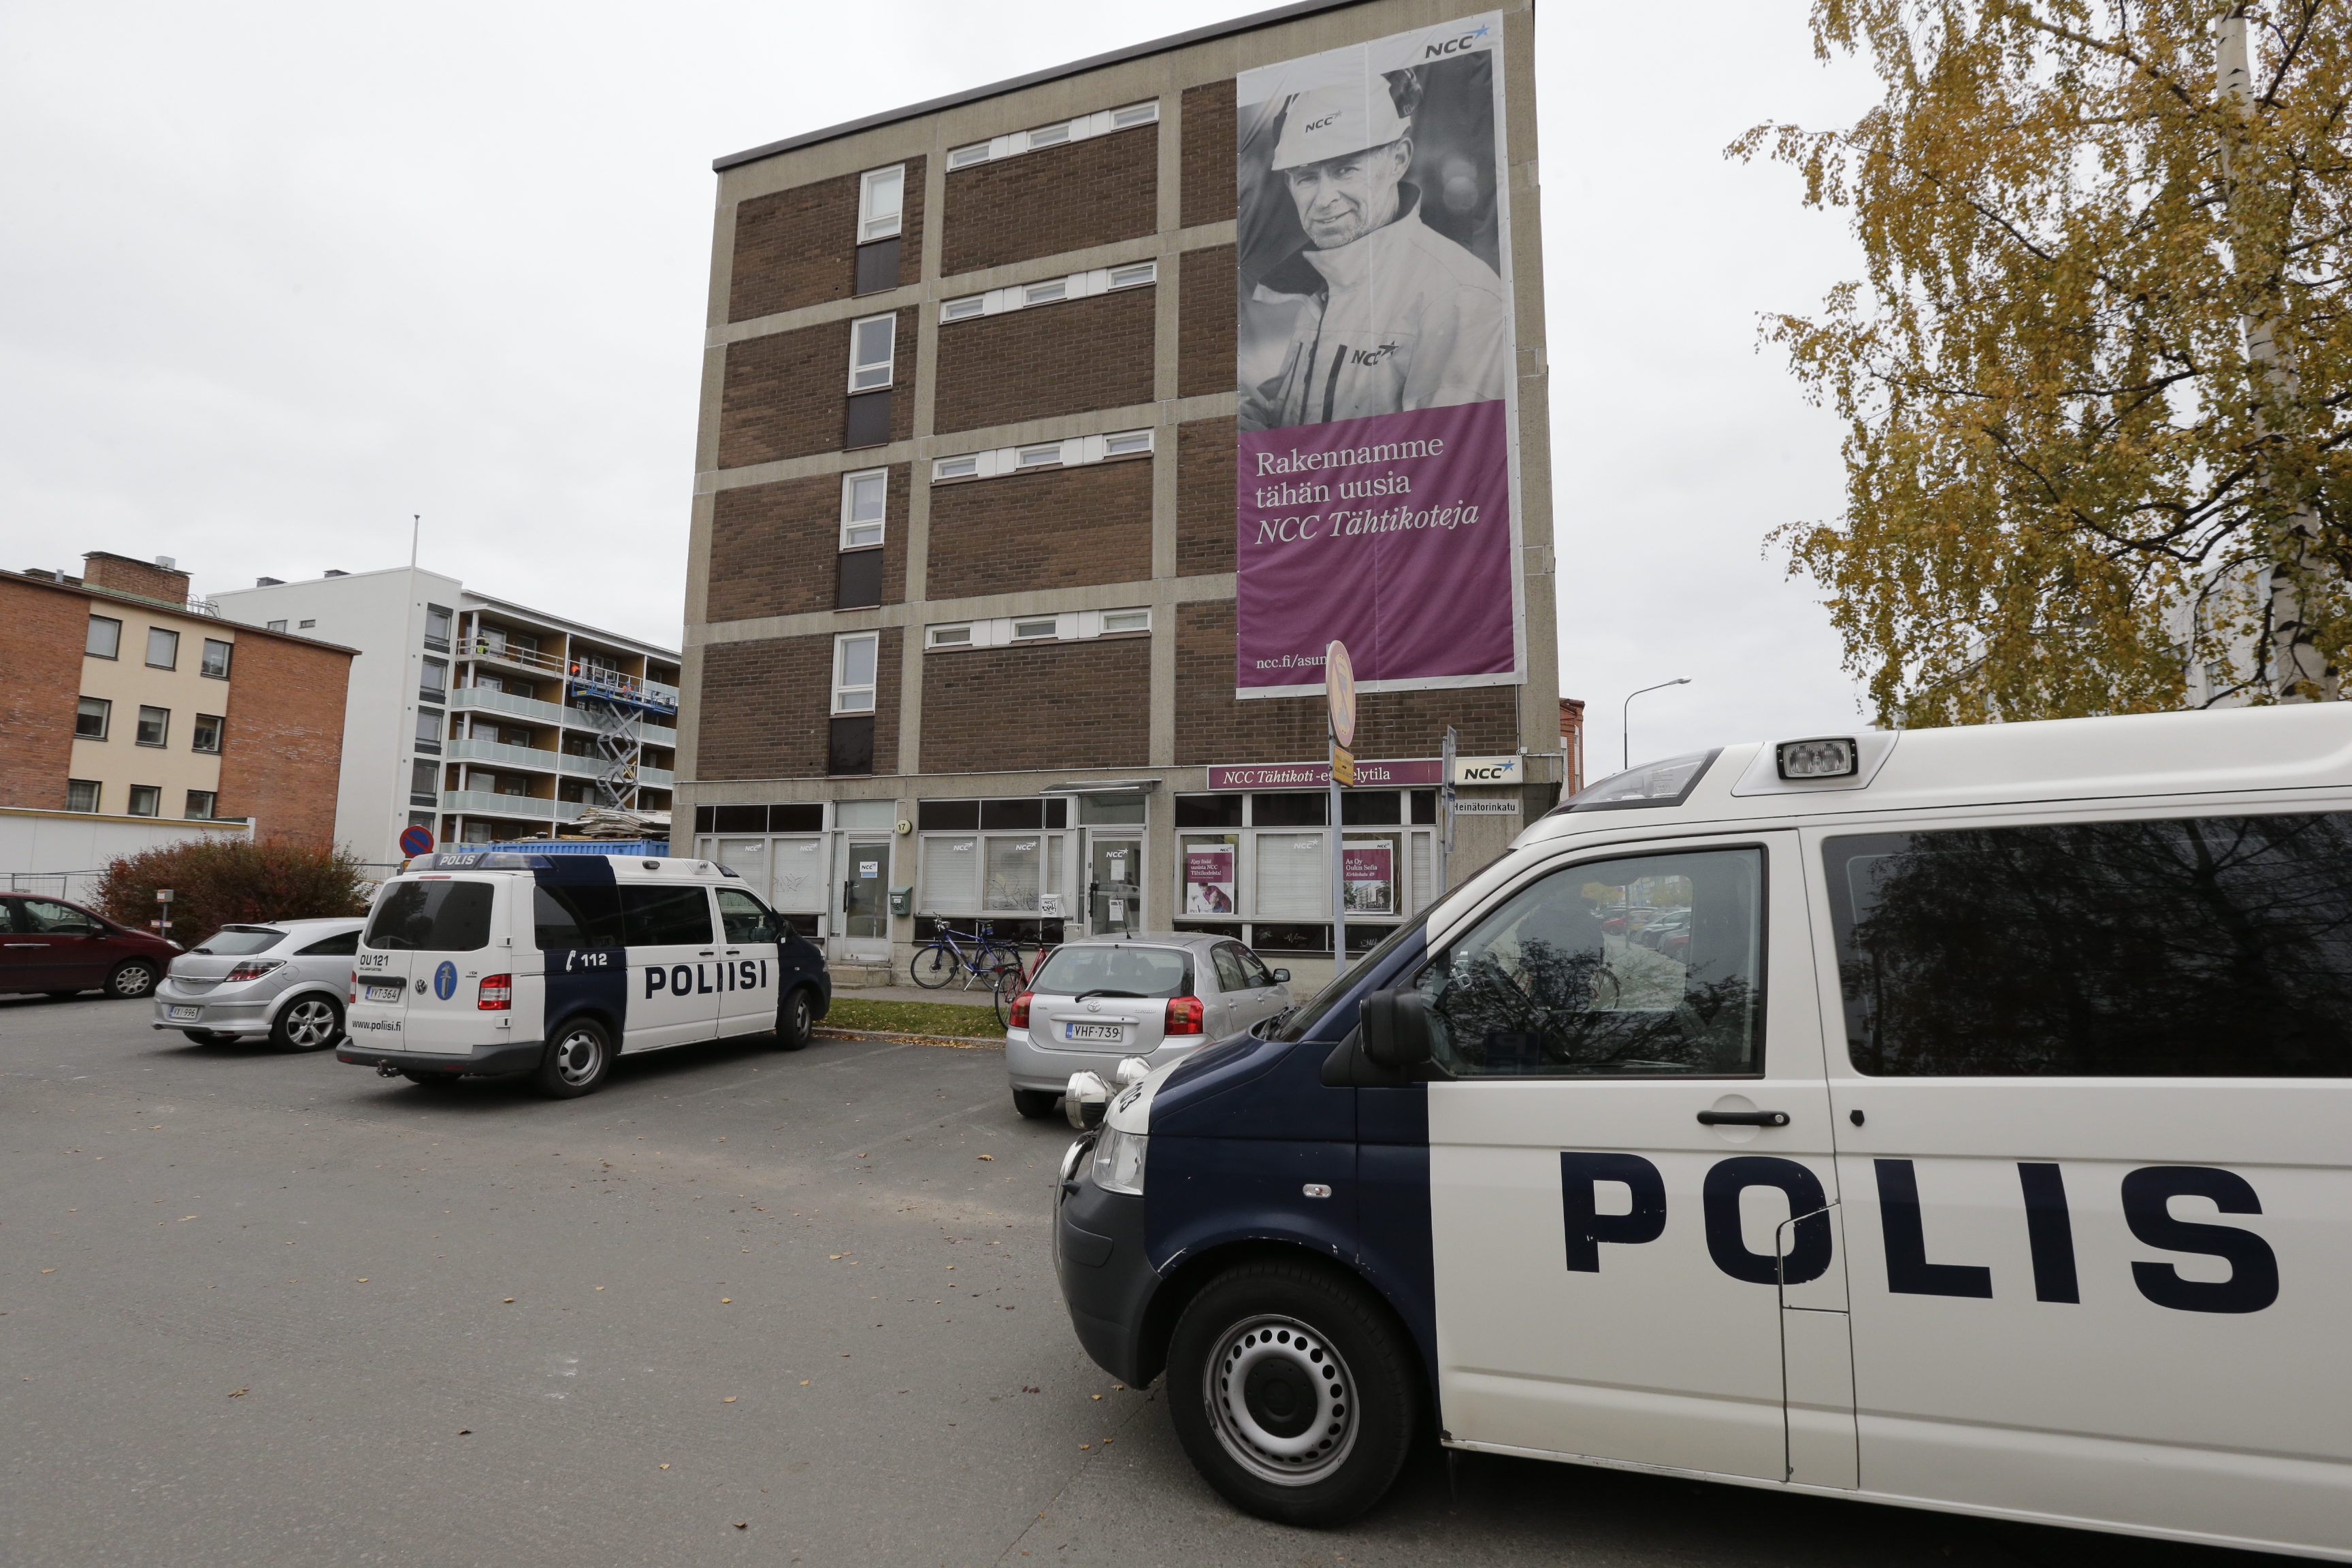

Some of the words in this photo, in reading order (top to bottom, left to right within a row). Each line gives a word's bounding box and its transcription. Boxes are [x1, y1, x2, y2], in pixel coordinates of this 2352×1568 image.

[1425, 35, 1474, 59] NCC
[1305, 116, 1333, 133] NCC
[1351, 349, 1382, 366] NCC
[1256, 437, 1443, 477] Rakennamme
[1256, 482, 1330, 509] tähän
[1339, 471, 1411, 500] uusia
[1255, 514, 1320, 544] NCC
[1329, 500, 1479, 538] Tähtikoteja
[1223, 771, 1255, 784] NCC
[1257, 770, 1314, 783] Tähtikoti
[1464, 768, 1502, 780] NCC
[439, 855, 476, 866] POLIS
[360, 954, 372, 966] OU
[374, 955, 389, 966] 121
[581, 953, 608, 966] 112
[644, 960, 767, 1000] POLIISI
[352, 1020, 402, 1032] www.poliisi.fi
[1560, 1152, 2280, 1314] POLIS
